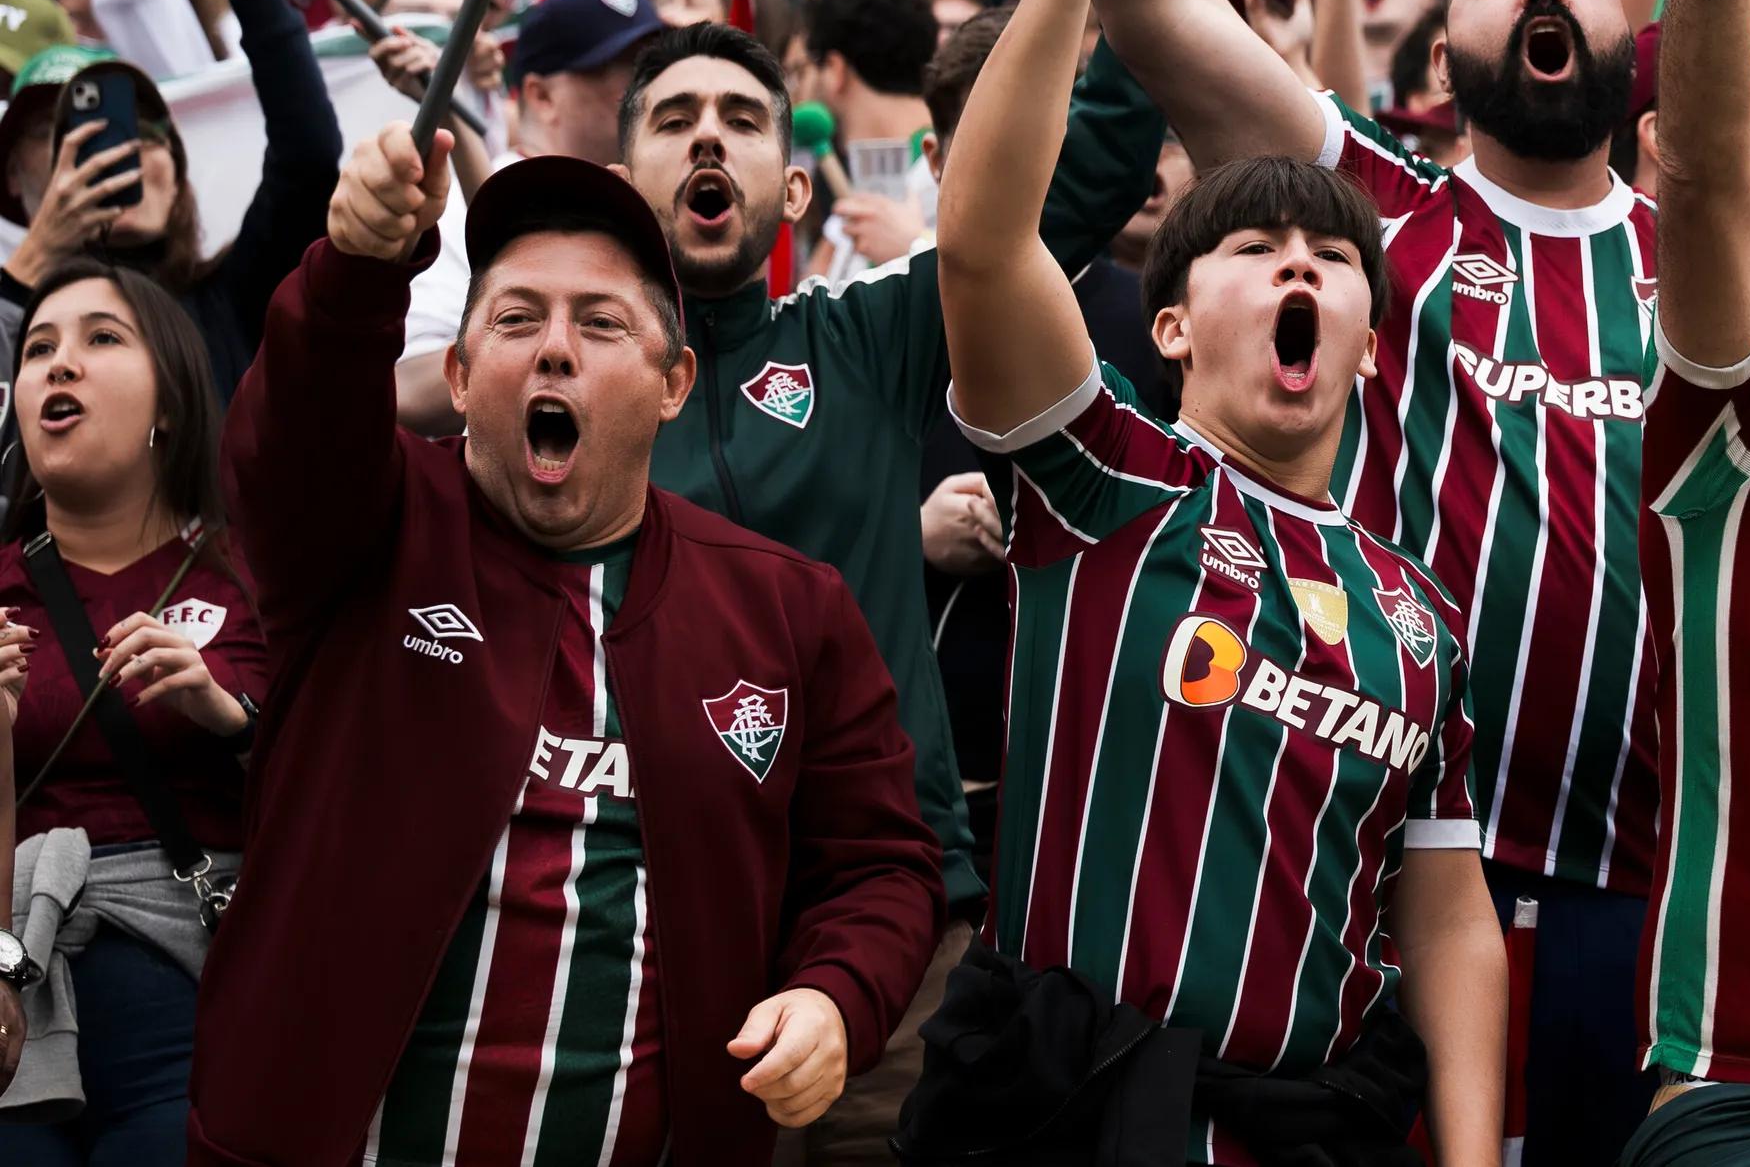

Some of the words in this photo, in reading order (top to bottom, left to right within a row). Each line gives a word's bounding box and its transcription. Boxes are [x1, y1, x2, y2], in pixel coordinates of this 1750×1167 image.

[1202, 552, 1260, 590] umbro
[403, 634, 464, 664] umbro
[1241, 658, 1430, 775] BETANO
[529, 724, 636, 798] ETA
